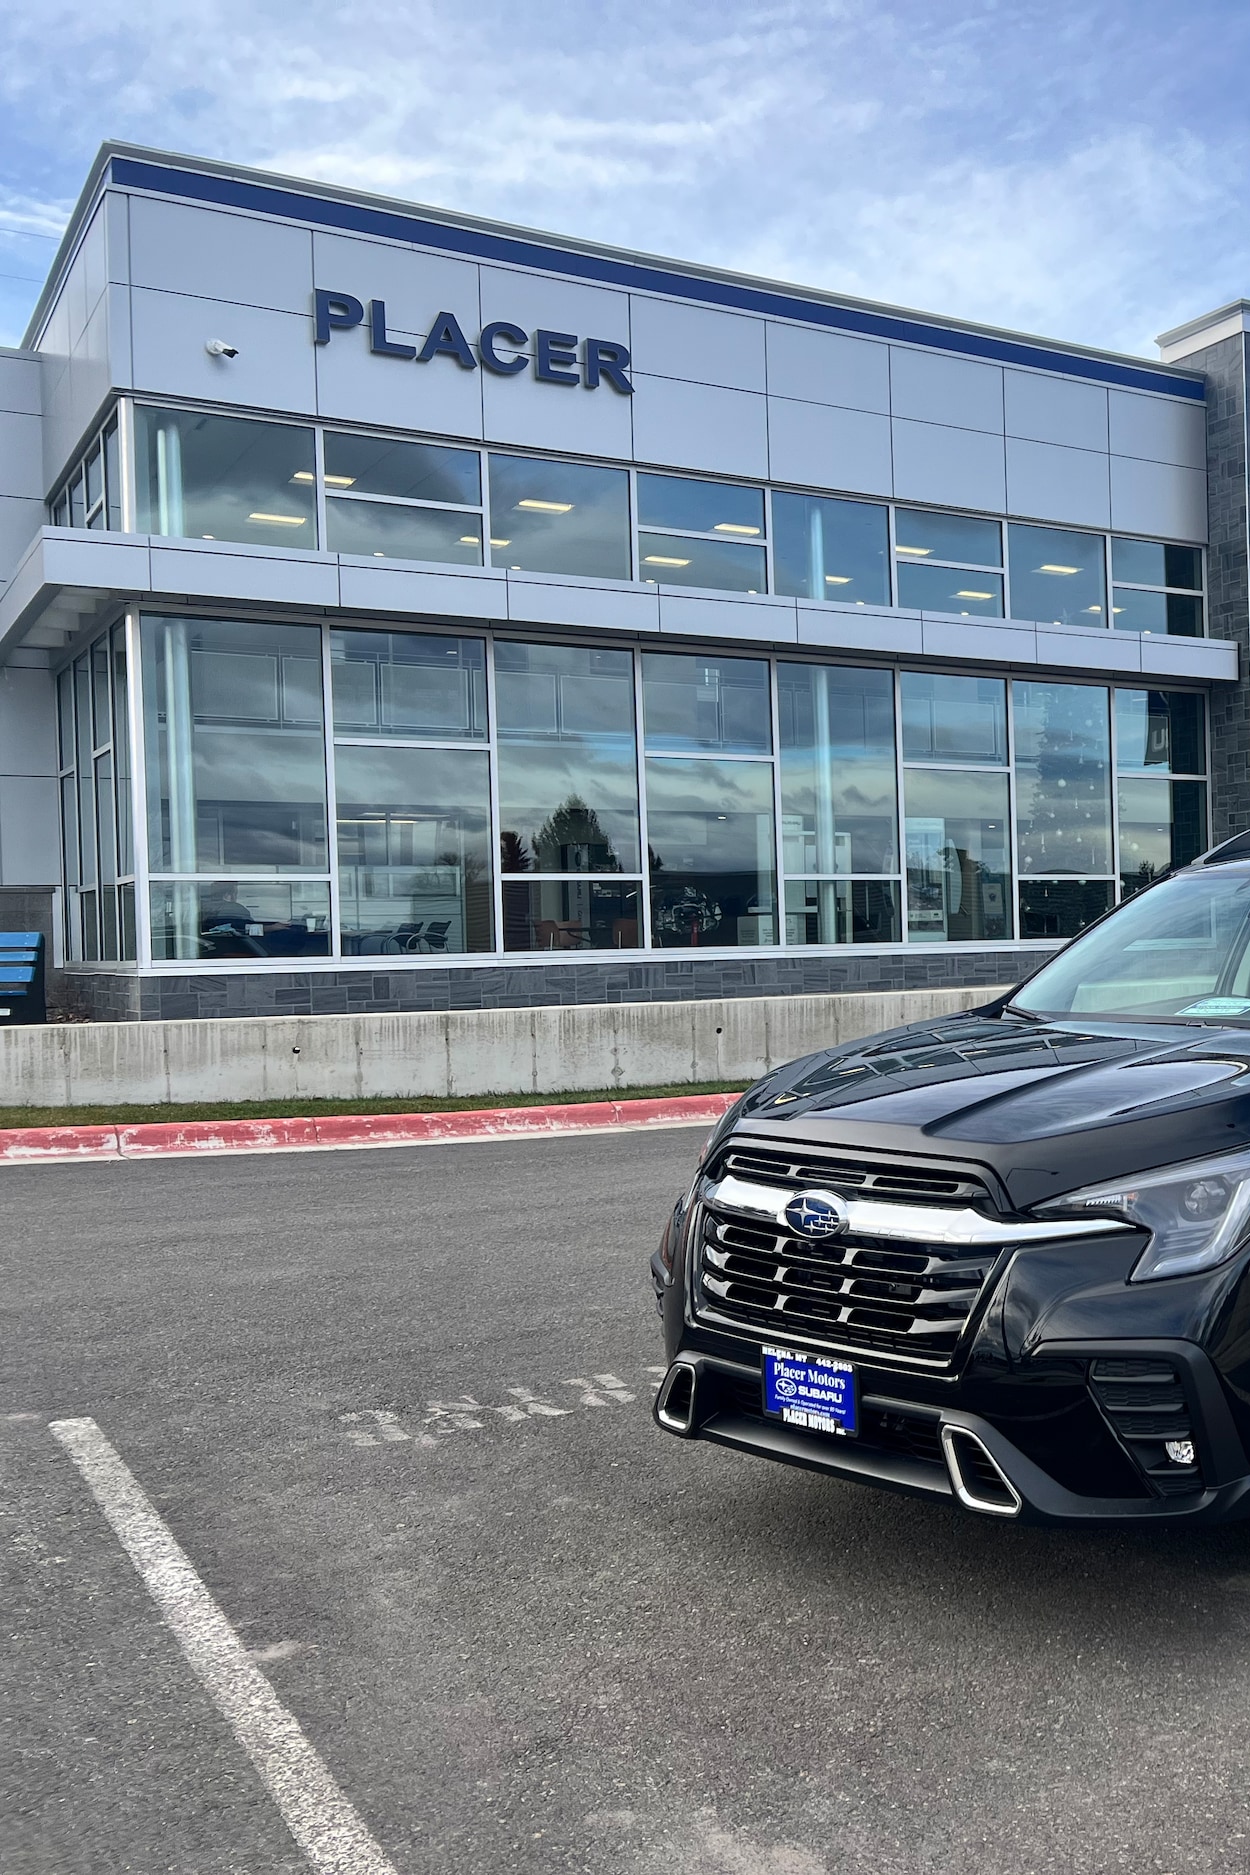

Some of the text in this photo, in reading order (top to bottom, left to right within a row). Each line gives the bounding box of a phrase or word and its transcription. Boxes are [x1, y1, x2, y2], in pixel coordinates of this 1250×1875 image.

[313, 288, 636, 394] PLACER
[774, 1362, 846, 1390] Placer Motors
[798, 1385, 843, 1403] SUBARU
[783, 1408, 807, 1427] PLACER
[808, 1415, 835, 1434] MOTORS
